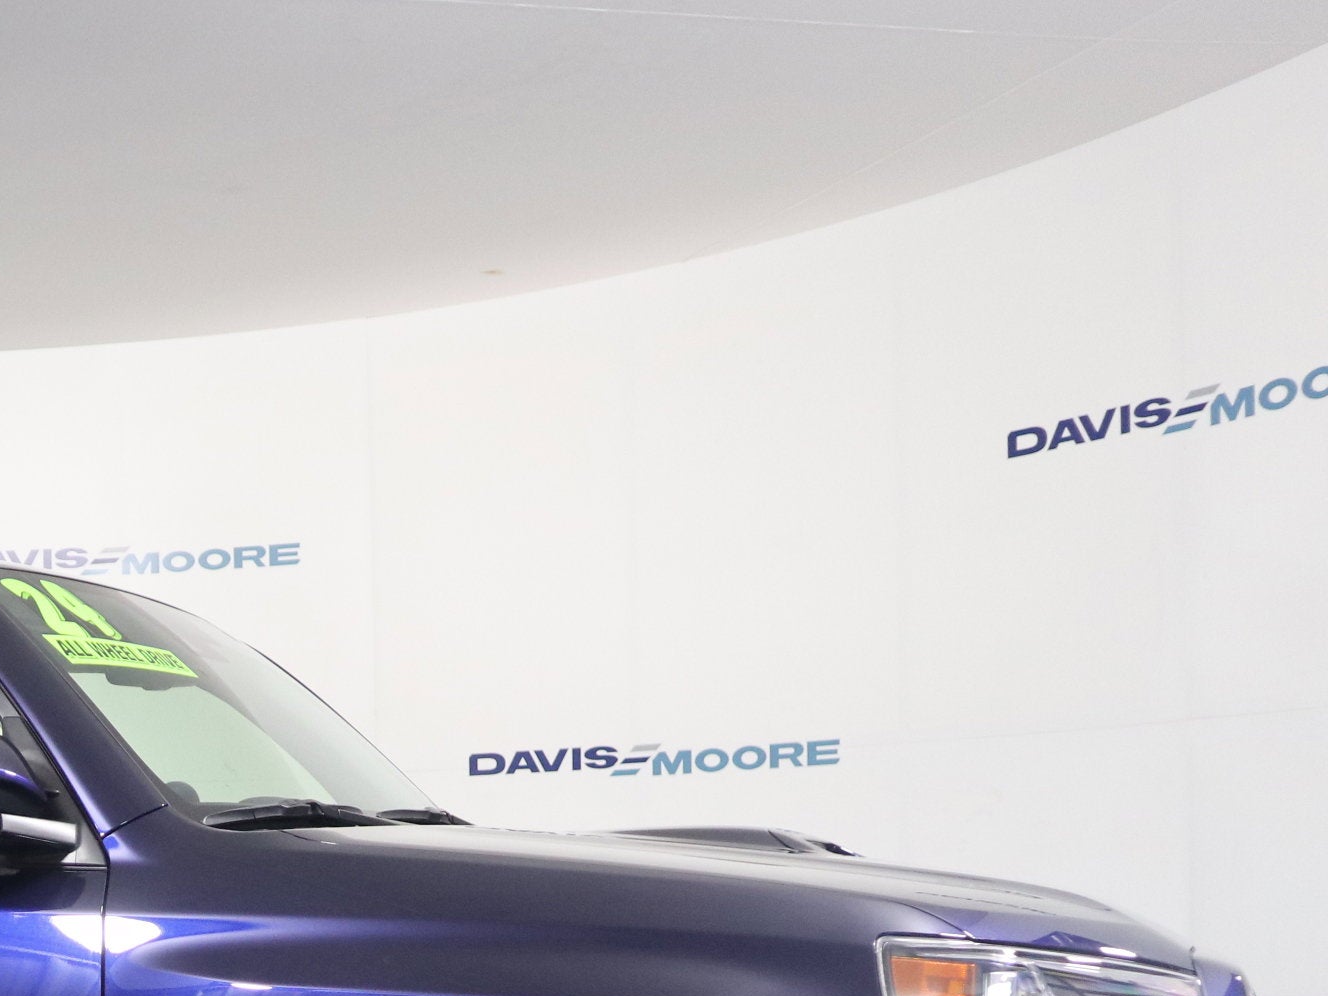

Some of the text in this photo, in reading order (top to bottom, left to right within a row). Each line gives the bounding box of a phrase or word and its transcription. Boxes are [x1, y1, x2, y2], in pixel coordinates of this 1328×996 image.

[1007, 397, 1172, 458] DAVIS
[122, 542, 301, 575] MOORE
[0, 578, 123, 641] 24
[56, 639, 185, 670] ALL WHEEL DRIVE
[469, 739, 840, 776] DAVIS MOORE
